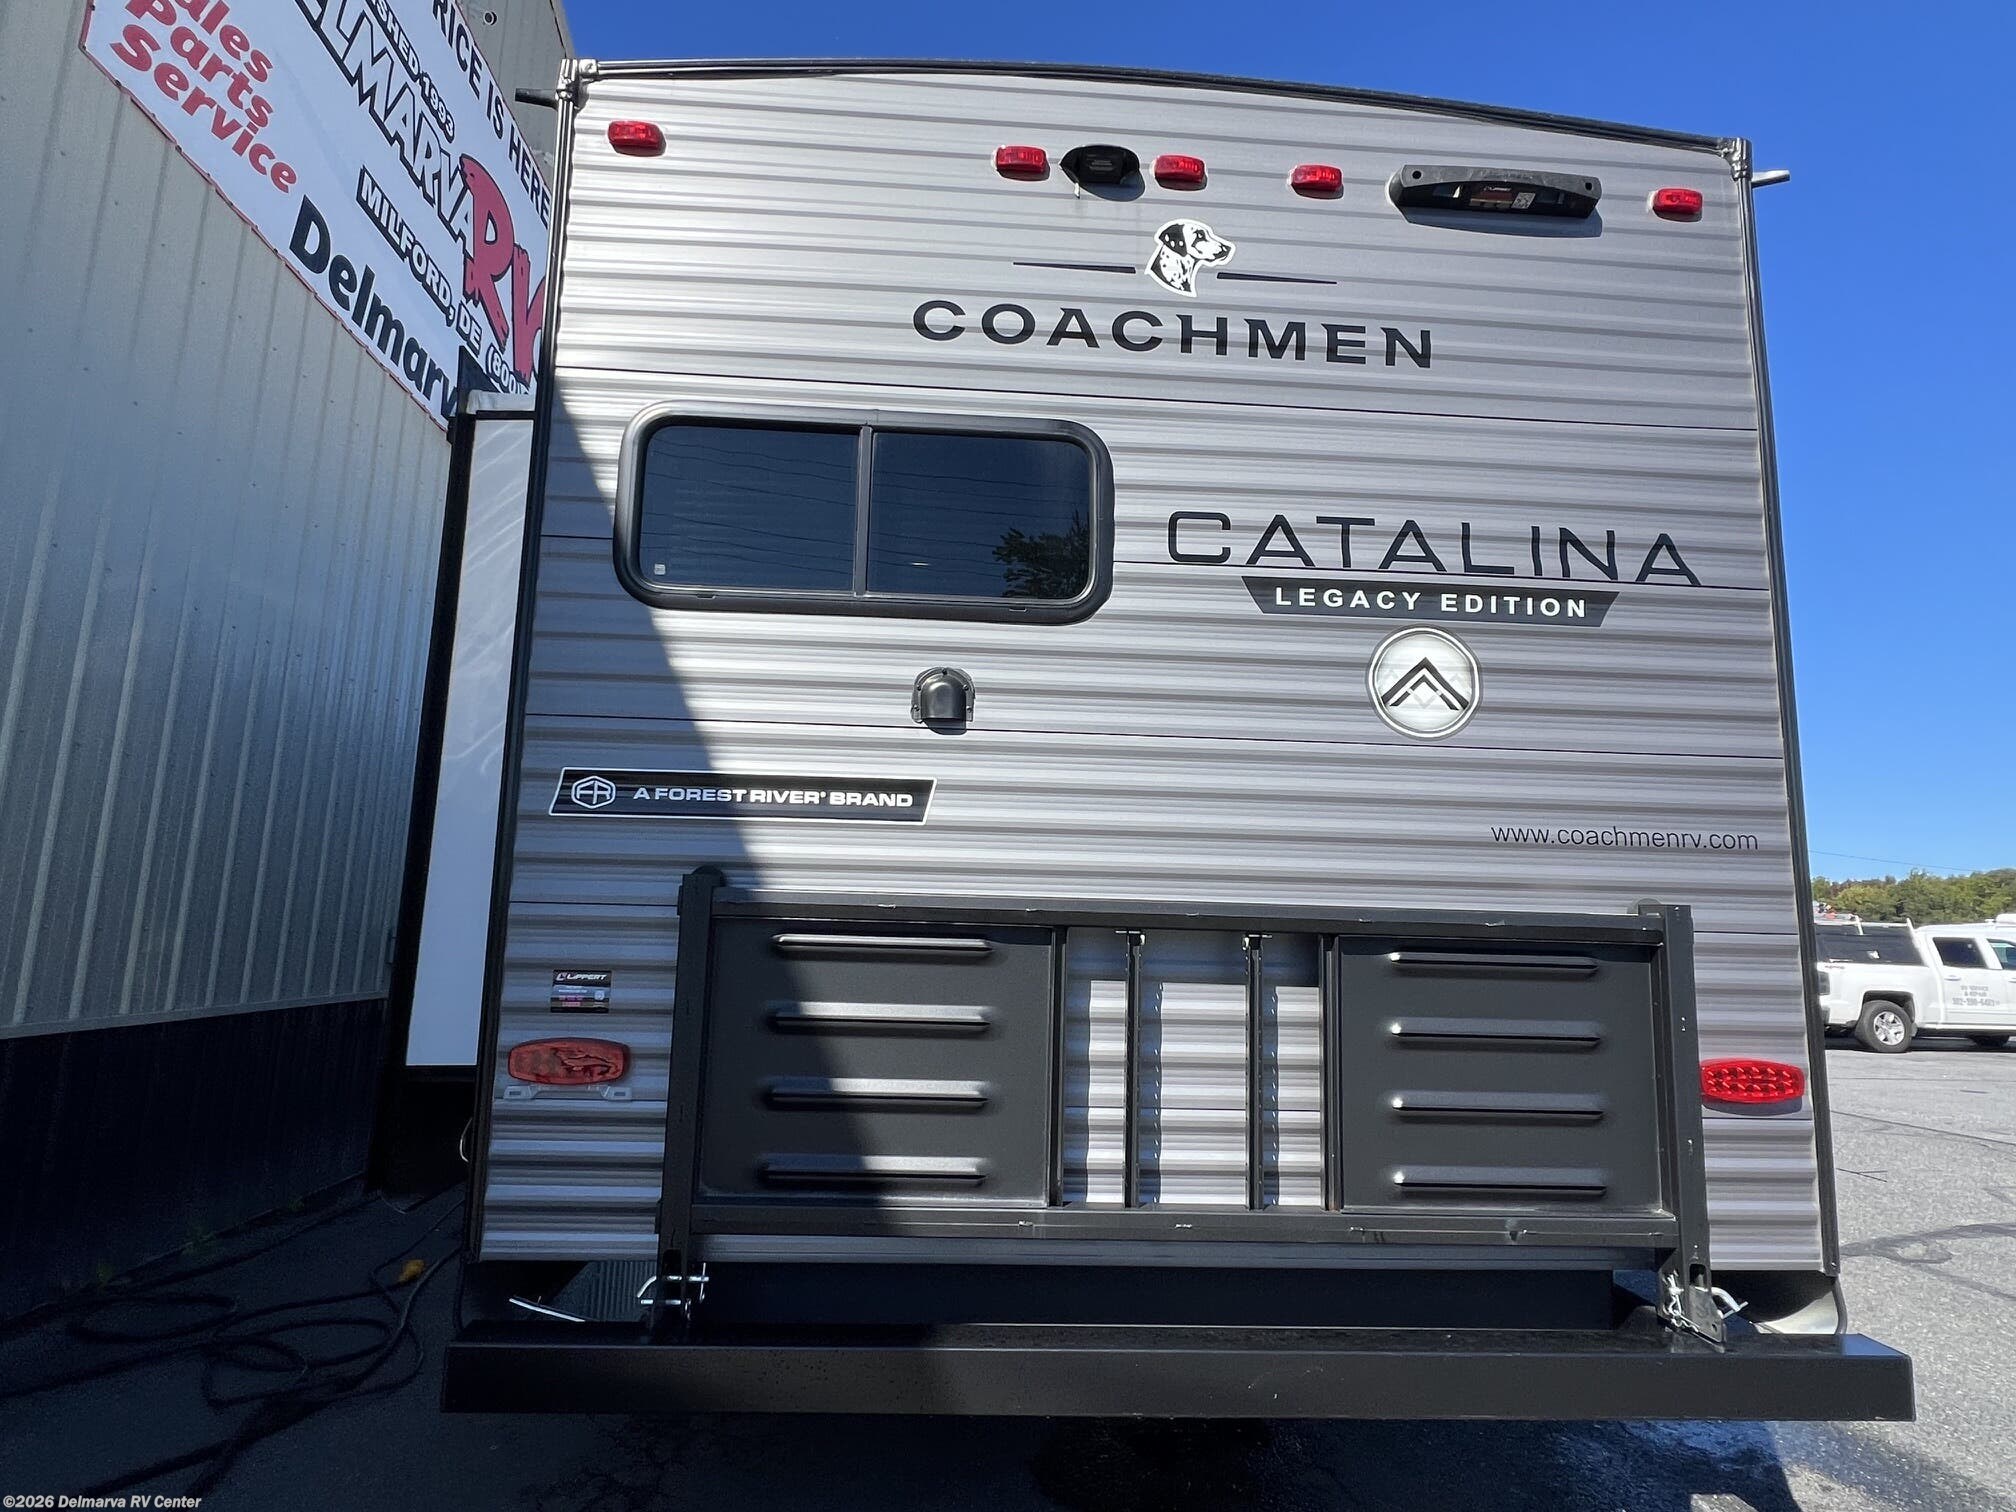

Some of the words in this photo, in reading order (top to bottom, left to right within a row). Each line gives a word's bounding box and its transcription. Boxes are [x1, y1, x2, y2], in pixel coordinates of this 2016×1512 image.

[109, 24, 298, 194] Service
[367, 0, 420, 83] SHED
[418, 70, 455, 144] 1993
[294, 0, 475, 259] LMARVA
[486, 80, 505, 140] IS
[508, 123, 552, 231] HERE
[356, 164, 456, 328] MILFORD,
[456, 300, 483, 358] DE
[912, 299, 1432, 369] COACHMEN
[1167, 510, 1702, 586] CATALINA
[1275, 586, 1422, 611] LEGACY
[1441, 593, 1586, 618] EDITION
[633, 786, 651, 800] A
[654, 787, 747, 803] FOREST
[829, 793, 914, 808] BRAND
[1490, 825, 1759, 850] www.coachmenrv.com
